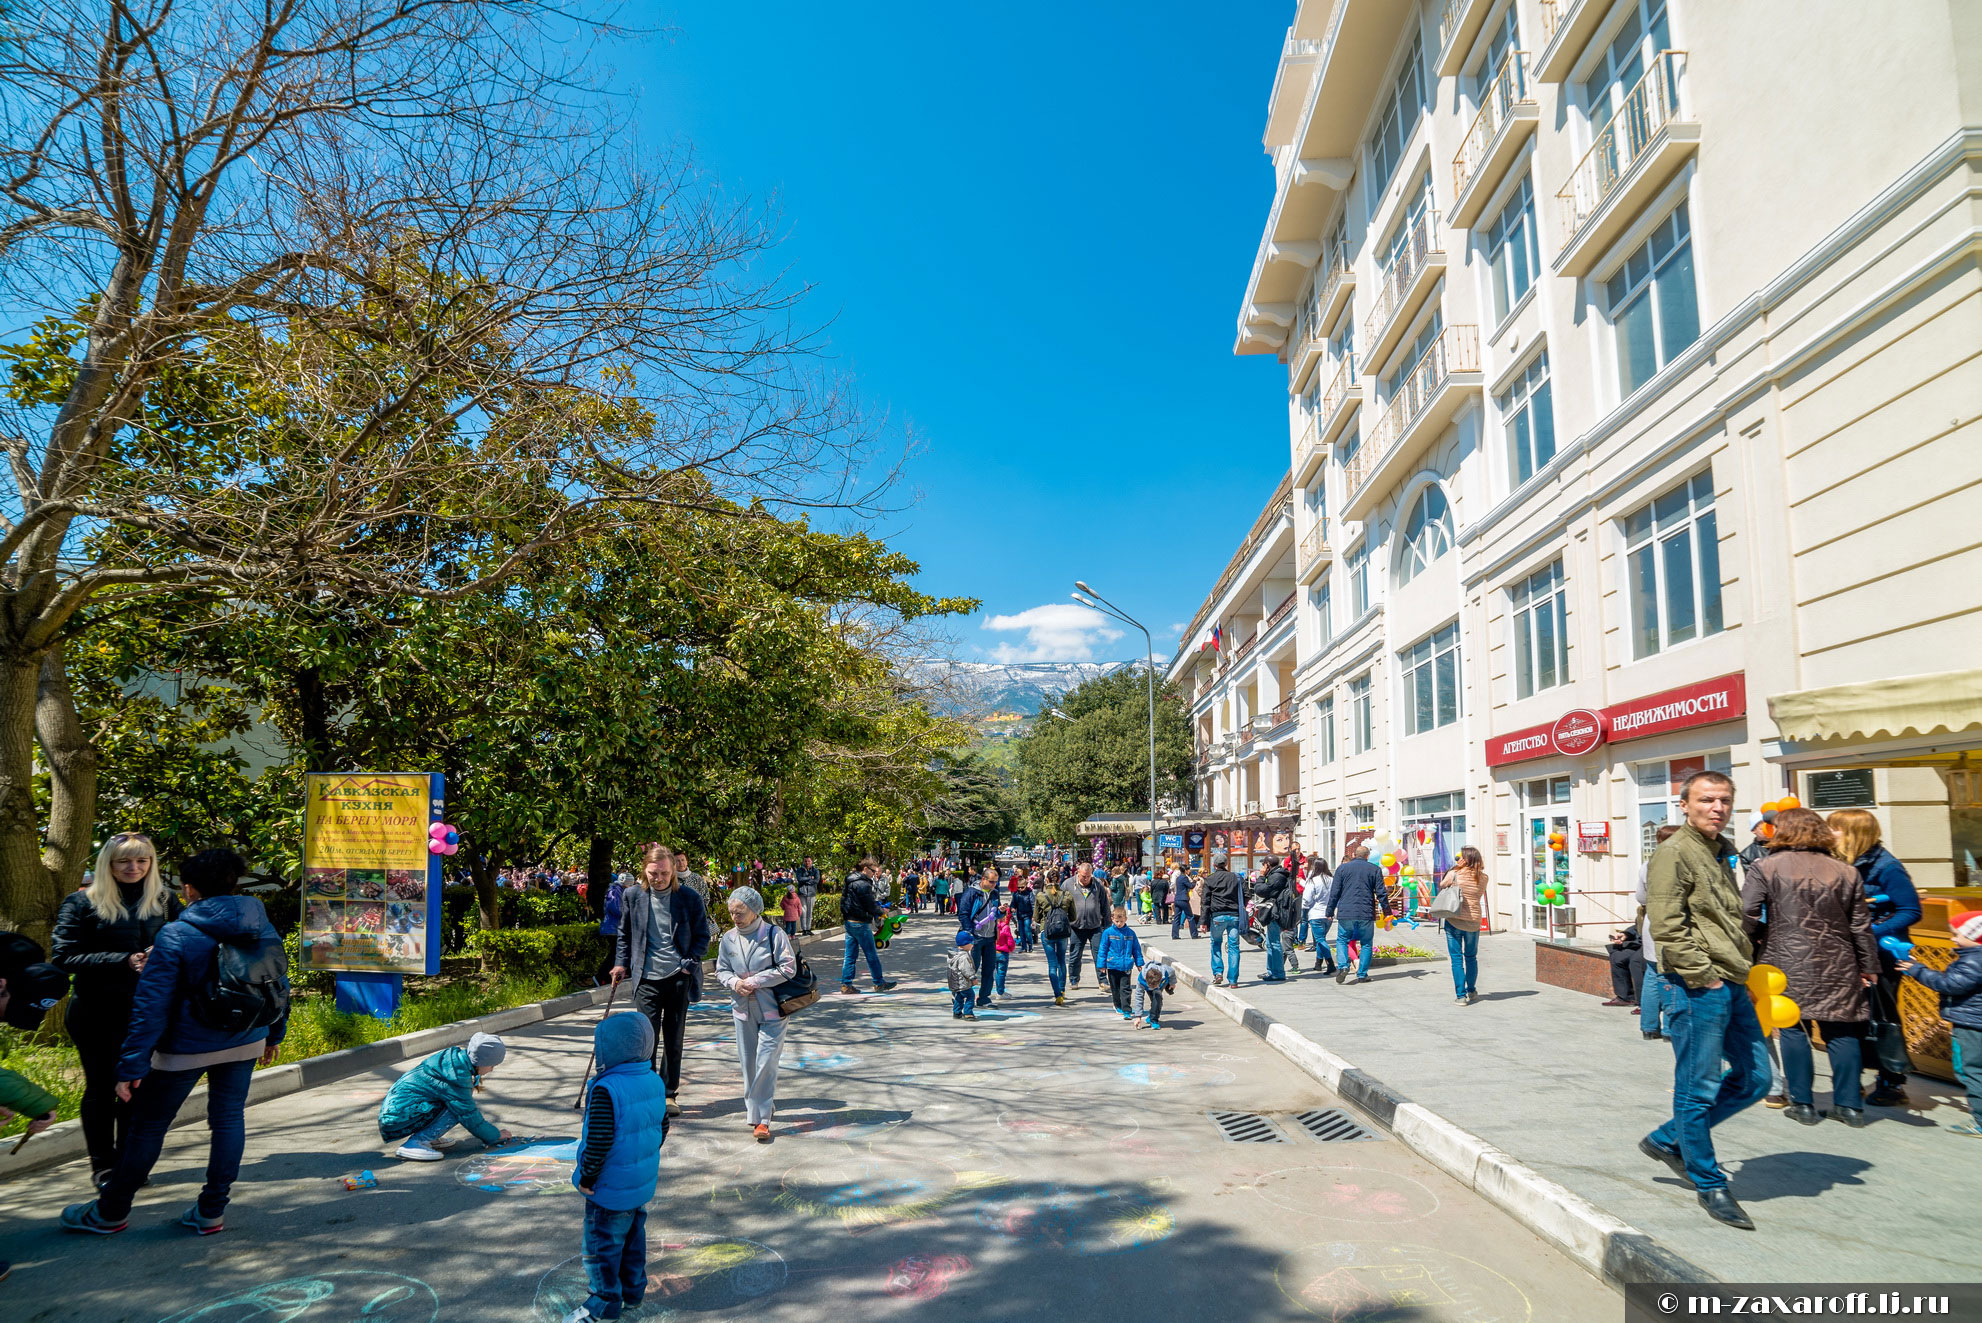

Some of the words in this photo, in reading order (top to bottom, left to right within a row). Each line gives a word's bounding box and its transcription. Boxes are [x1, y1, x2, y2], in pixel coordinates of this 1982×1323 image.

[1503, 733, 1548, 755] АГЕНТСТВО
[1612, 691, 1729, 732] НЕДВИЖИМОСТИ
[1558, 731, 1571, 740] ПЯТЬ
[1570, 726, 1594, 737] СЕЗОНОВ
[341, 801, 393, 811] КУХНЯ
[316, 815, 332, 825] НА
[335, 815, 381, 826] БЕРЕГУ
[382, 816, 418, 826] МОРЯ
